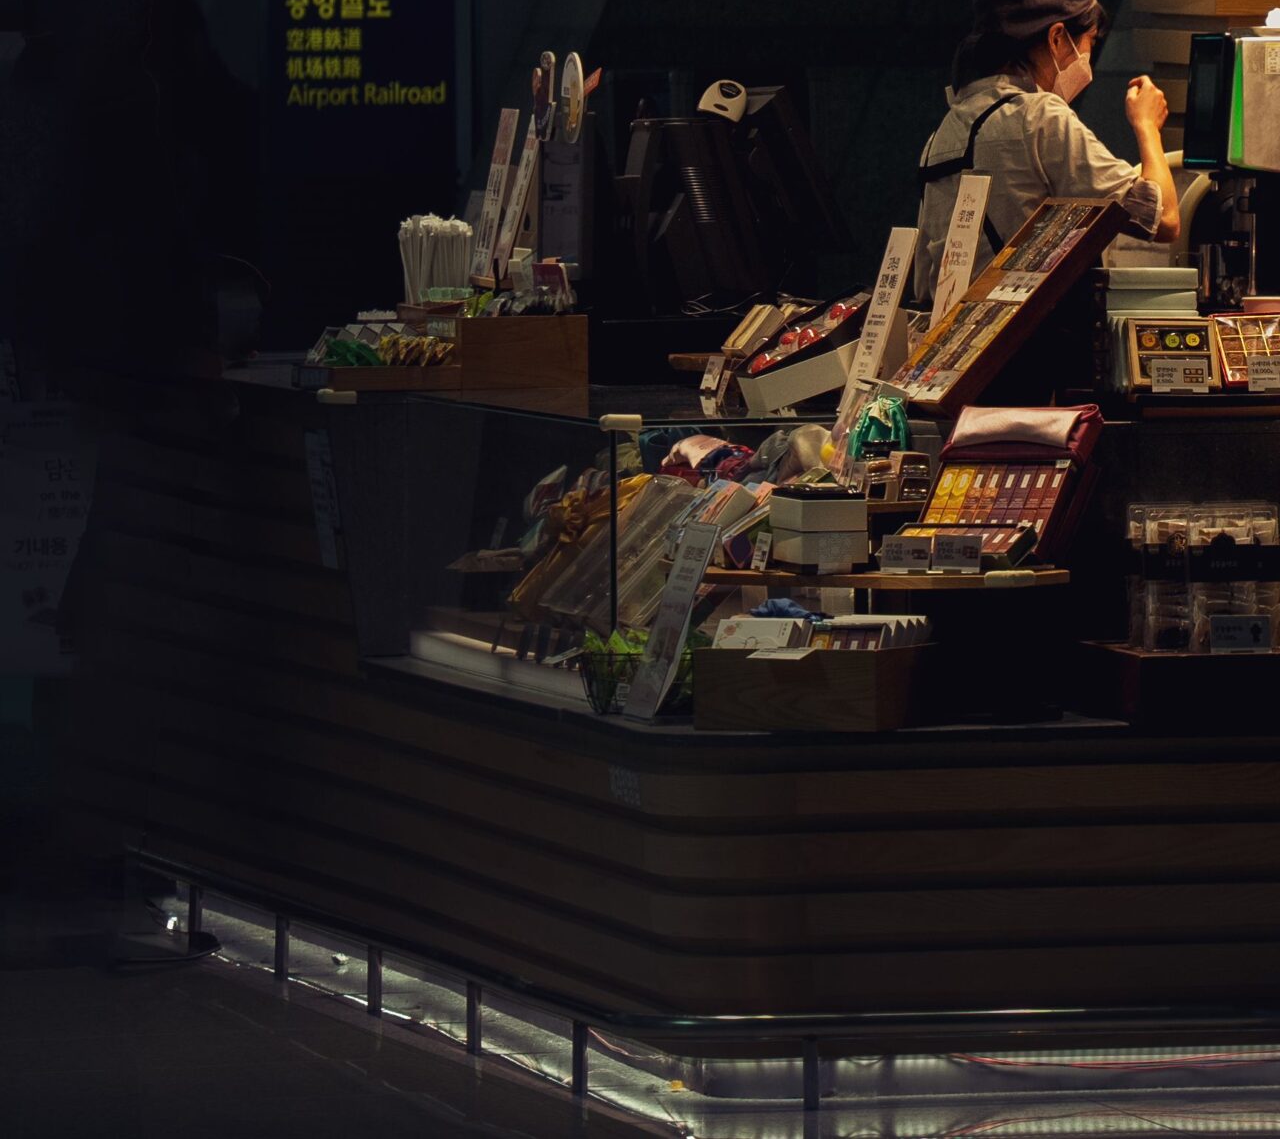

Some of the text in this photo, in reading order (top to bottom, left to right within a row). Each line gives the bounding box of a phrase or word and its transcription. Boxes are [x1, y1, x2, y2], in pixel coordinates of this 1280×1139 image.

[285, 26, 363, 52] 空港鉄道
[285, 56, 363, 80] 机场铁路
[286, 78, 448, 110] Airport Railroad
